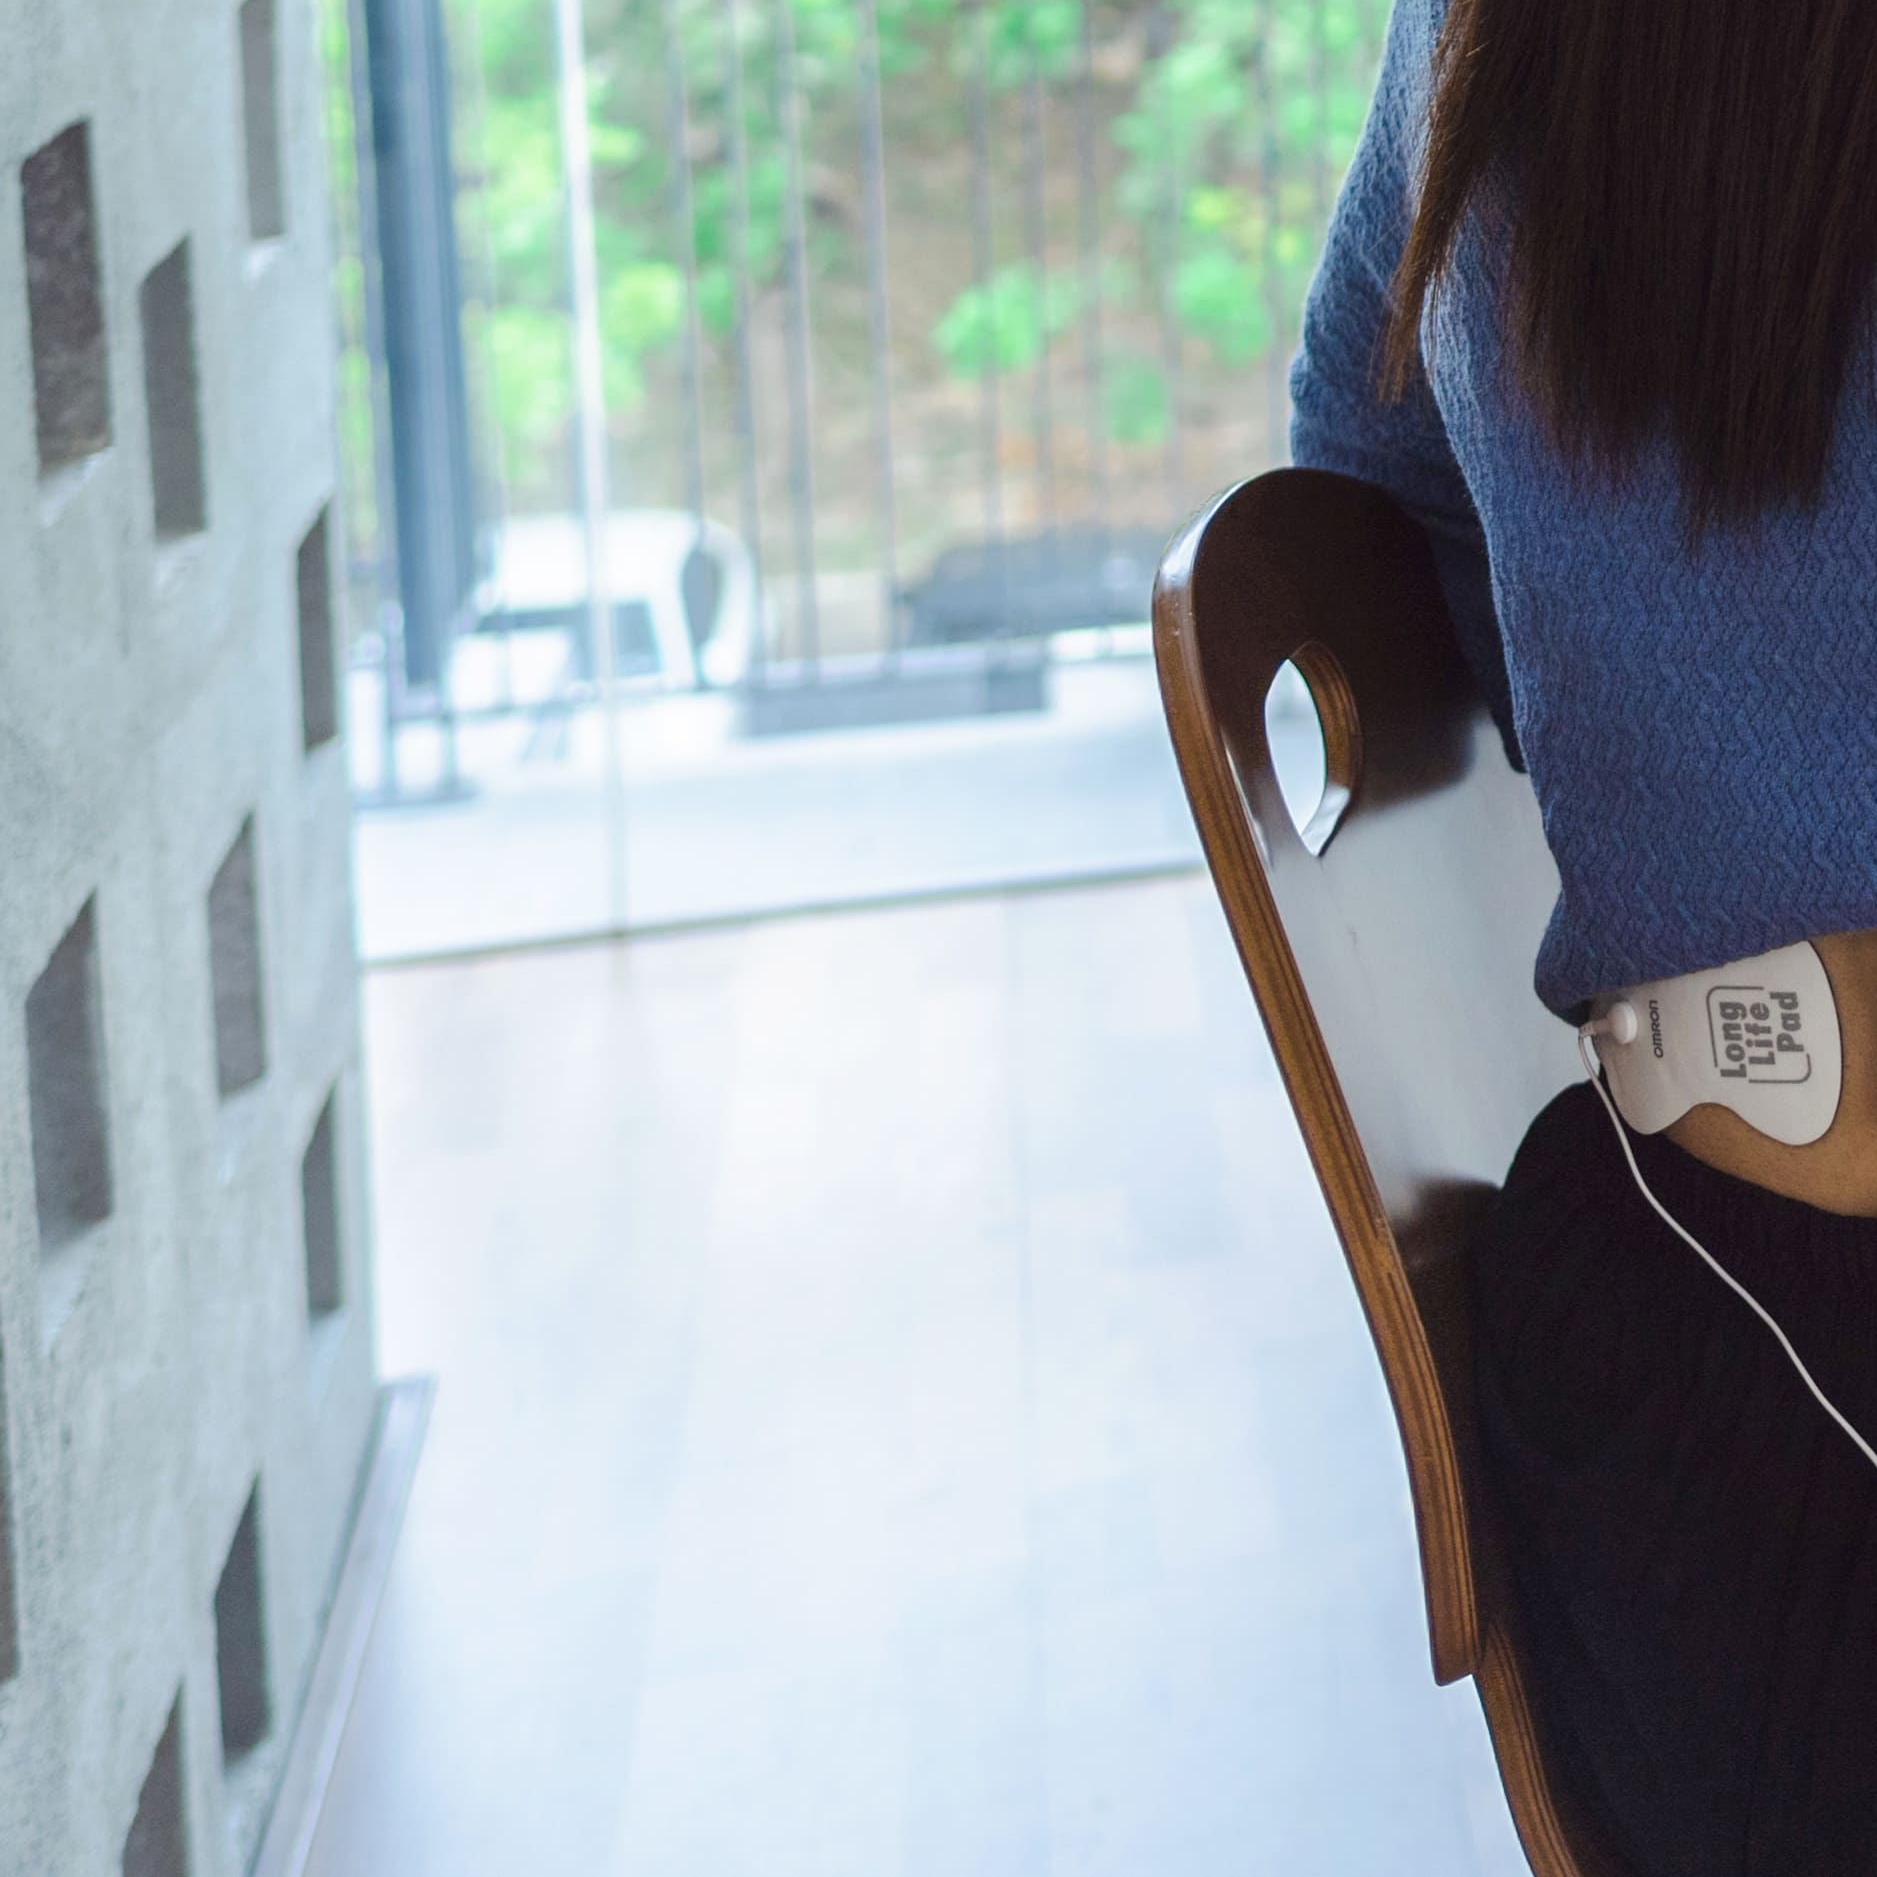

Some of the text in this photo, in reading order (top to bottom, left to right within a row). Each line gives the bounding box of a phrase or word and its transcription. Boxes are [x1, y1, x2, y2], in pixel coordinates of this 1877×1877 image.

[1649, 999, 1664, 1058] OMRON
[1719, 1001, 1747, 1078] Long
[1744, 1002, 1776, 1065] Life
[1769, 991, 1805, 1052] Pad
